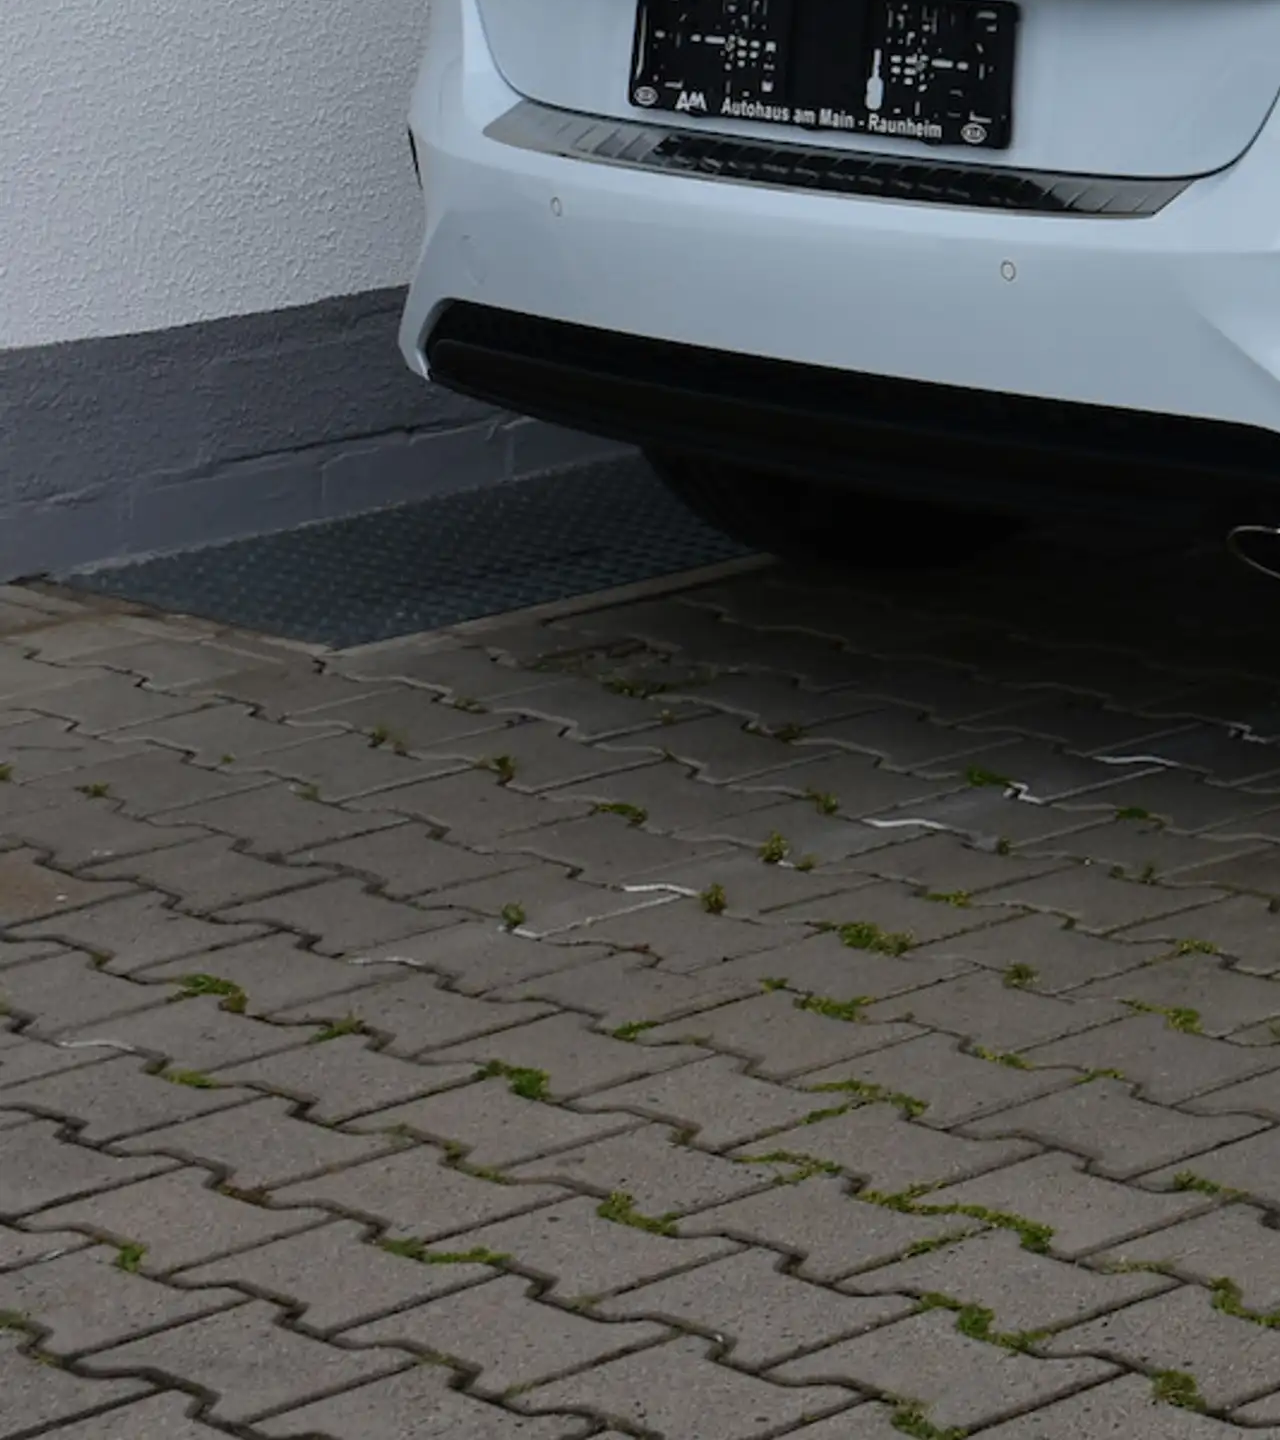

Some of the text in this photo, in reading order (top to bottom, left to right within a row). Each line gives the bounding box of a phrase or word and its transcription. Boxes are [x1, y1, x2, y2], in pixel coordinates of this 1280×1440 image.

[720, 96, 790, 123] Autohaus
[793, 109, 816, 125] am
[819, 108, 855, 129] Main
[867, 112, 943, 139] Raunheim
